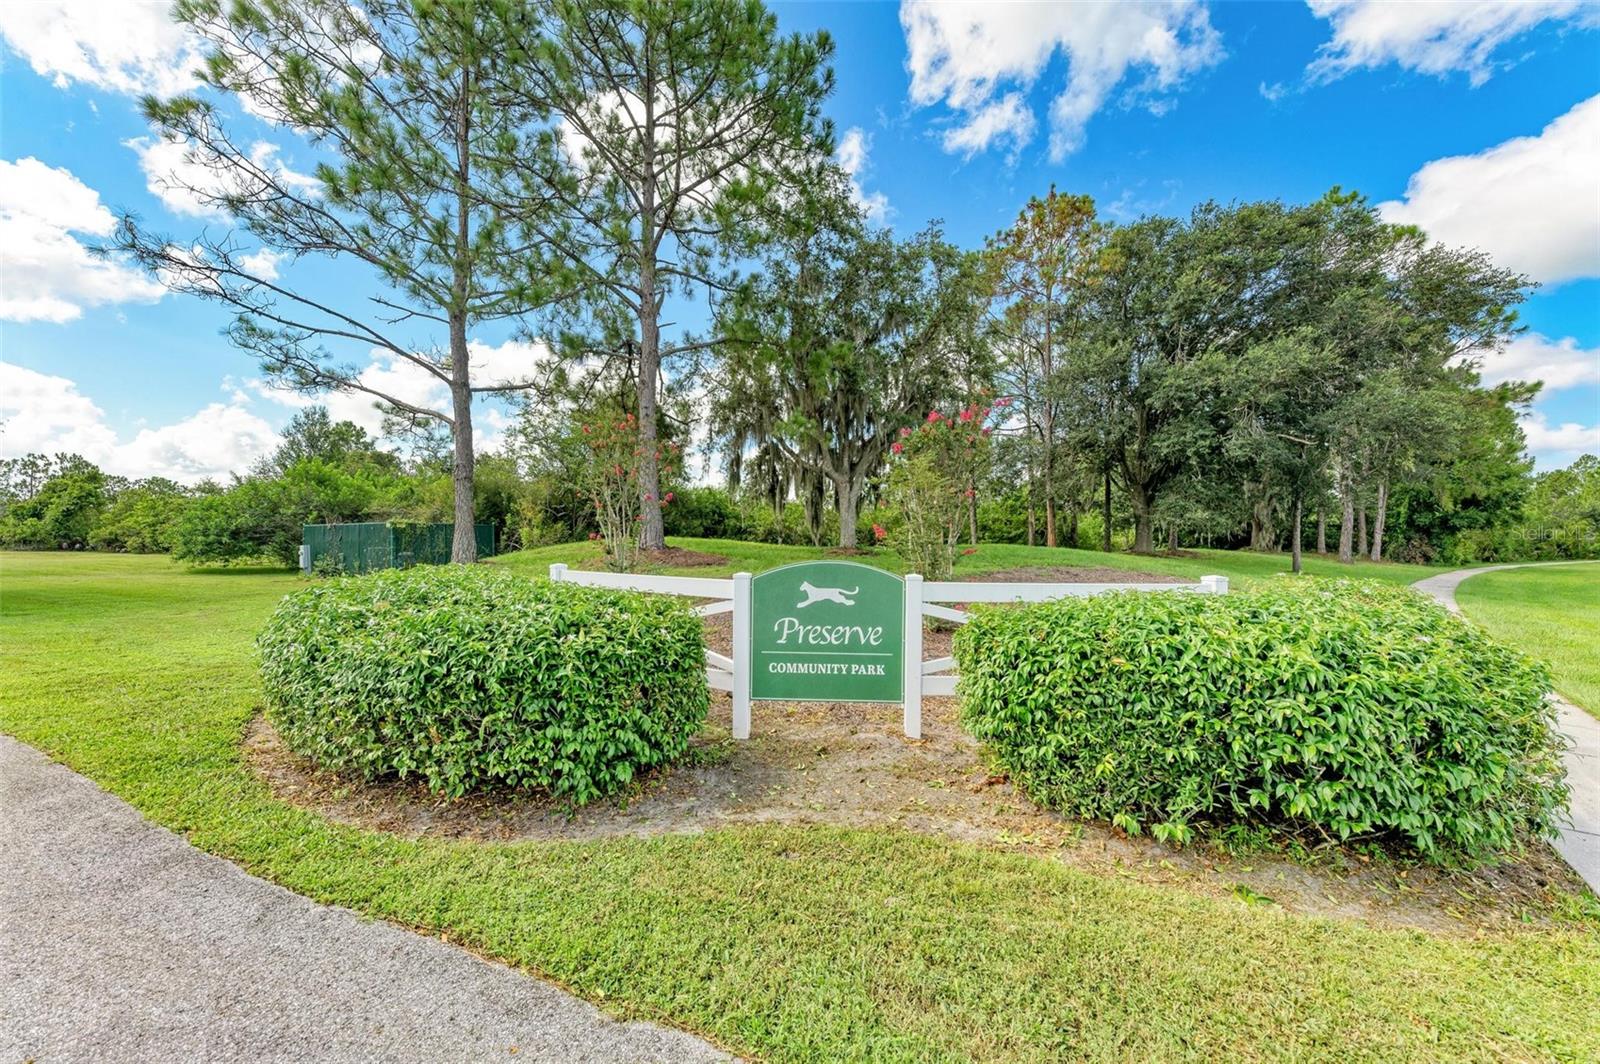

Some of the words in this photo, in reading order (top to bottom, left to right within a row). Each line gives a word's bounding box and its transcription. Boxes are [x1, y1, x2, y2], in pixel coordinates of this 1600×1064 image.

[774, 617, 883, 646] Preserve
[768, 662, 849, 675] COMMUNITY
[851, 664, 885, 676] PARK
